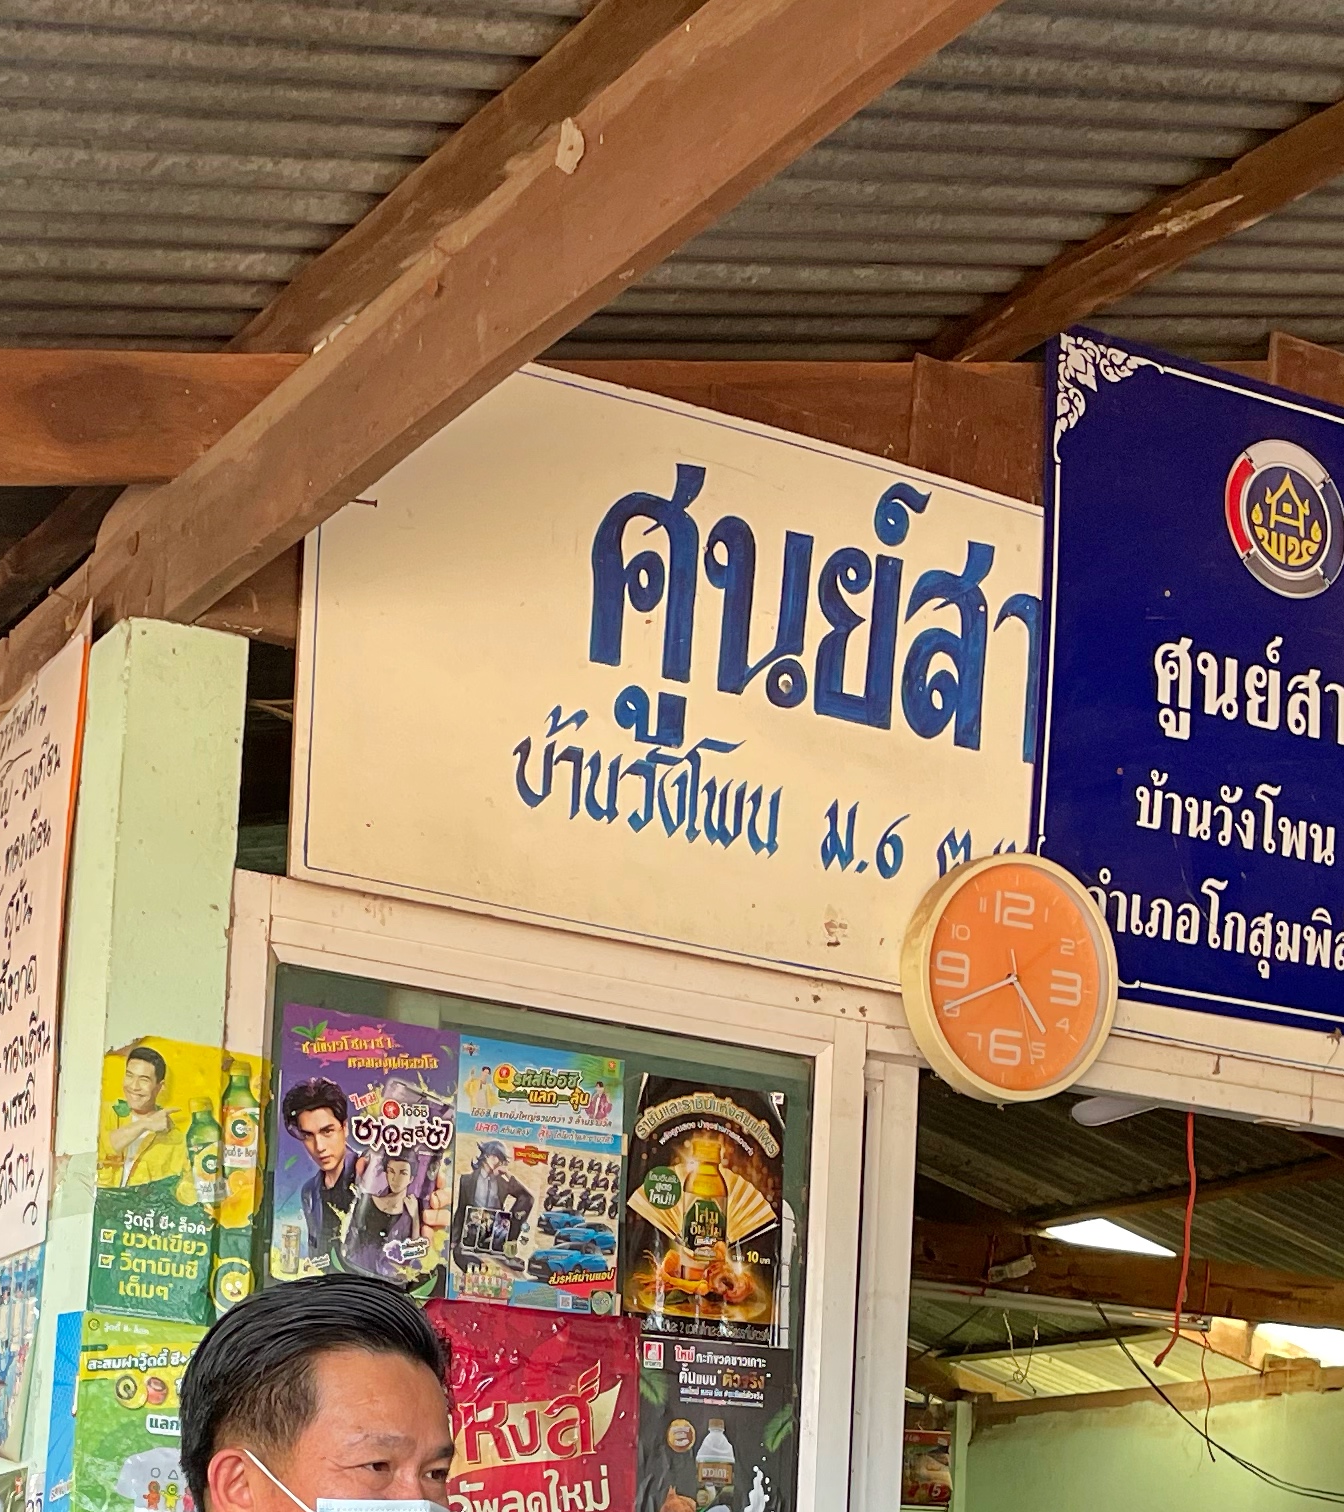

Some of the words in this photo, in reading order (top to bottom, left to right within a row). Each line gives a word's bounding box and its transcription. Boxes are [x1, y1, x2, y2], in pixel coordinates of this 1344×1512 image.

[513, 704, 785, 858] บ้านวังโพน
[1134, 770, 1335, 868] บ้านวังโพน
[994, 890, 1035, 930] 12
[951, 923, 971, 941] 10
[1060, 937, 1077, 956] 2
[935, 949, 971, 989] 9
[1049, 969, 1083, 1007] 3
[1055, 1017, 1070, 1033] 4
[966, 1031, 982, 1051] 7
[988, 1027, 1024, 1067] 6
[528, 1089, 558, 1104] แลก
[119, 1252, 199, 1281] วิตามินซี
[747, 1251, 760, 1264] 10
[149, 1417, 181, 1432] แลก
